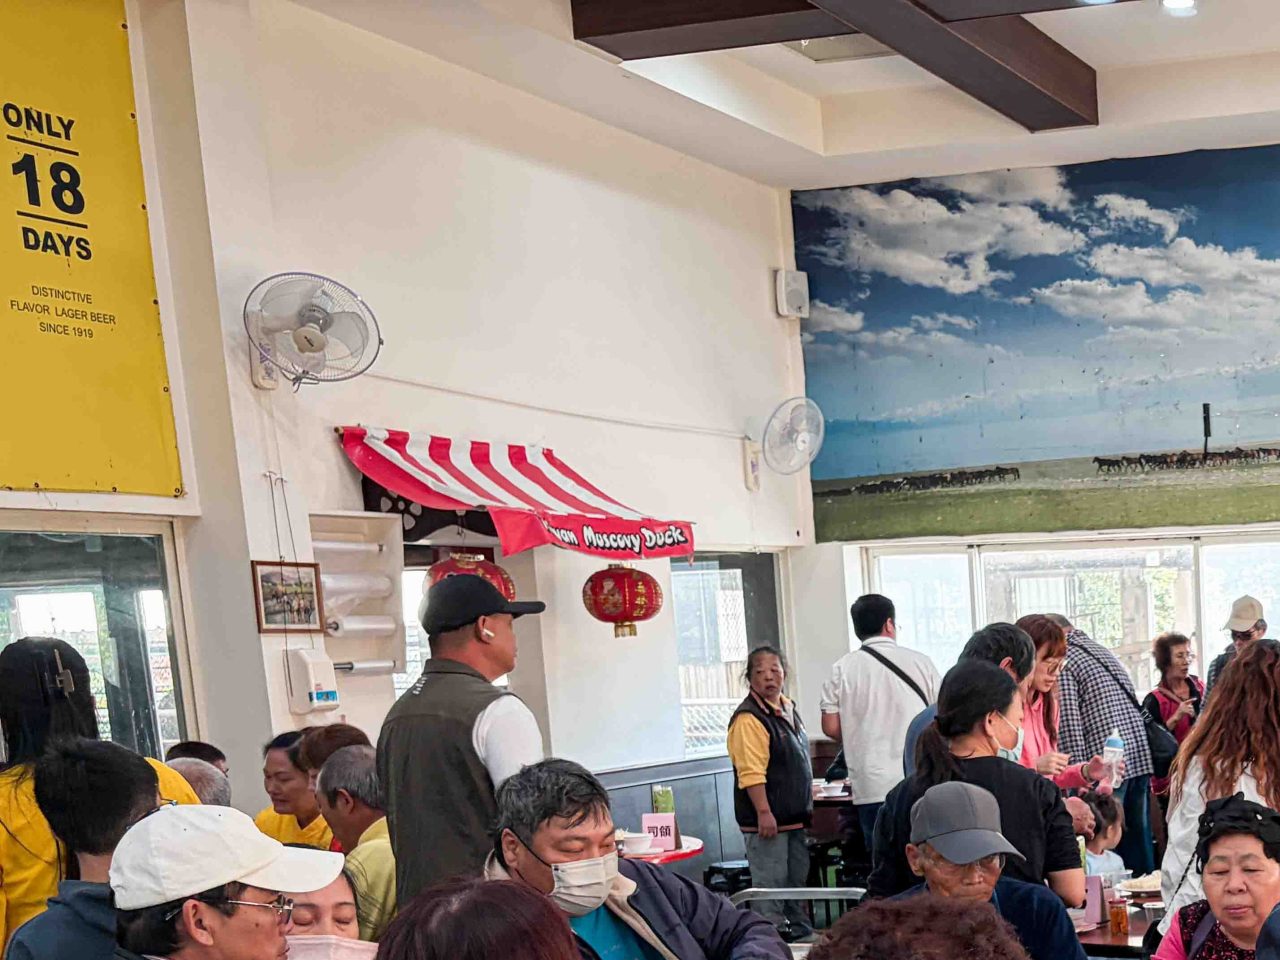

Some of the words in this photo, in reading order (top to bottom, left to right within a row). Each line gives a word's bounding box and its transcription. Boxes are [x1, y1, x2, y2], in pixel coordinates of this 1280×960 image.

[2, 102, 75, 141] ONLY
[12, 153, 85, 215] 18
[21, 226, 93, 261] DAYS
[31, 285, 93, 304] DISTINCTIVE
[10, 300, 50, 315] FLAVOR
[55, 306, 89, 321] LAGER
[90, 311, 116, 325] BEER
[39, 321, 69, 336] SINCE
[72, 326, 94, 339] 1919
[582, 525, 642, 555] Muscovy
[640, 525, 688, 548] Duck
